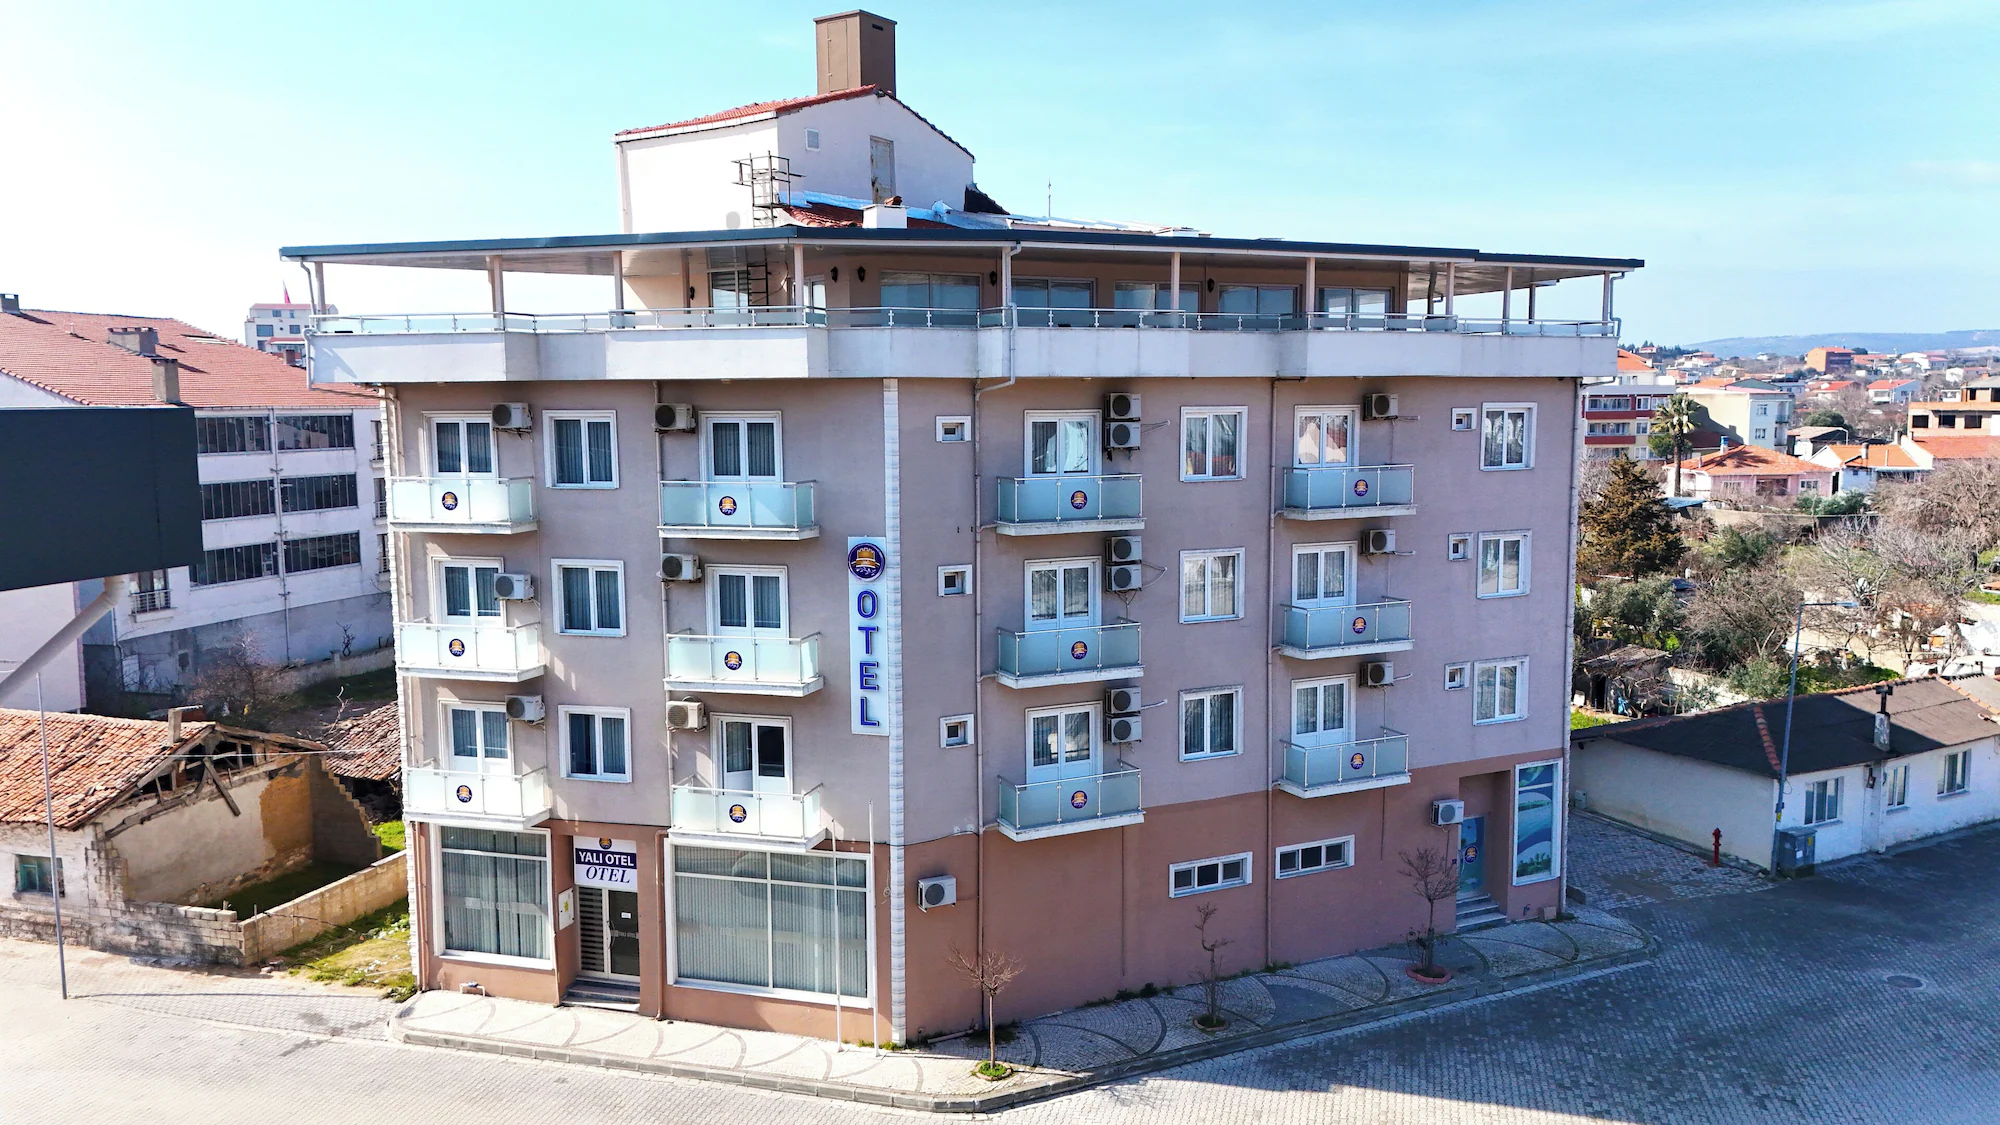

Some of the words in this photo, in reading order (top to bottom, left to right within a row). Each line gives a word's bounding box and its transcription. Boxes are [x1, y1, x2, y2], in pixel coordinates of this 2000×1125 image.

[857, 589, 880, 727] OTEL
[579, 851, 603, 864] YALI
[605, 853, 634, 867] OTEL
[586, 865, 631, 884] OTEL
